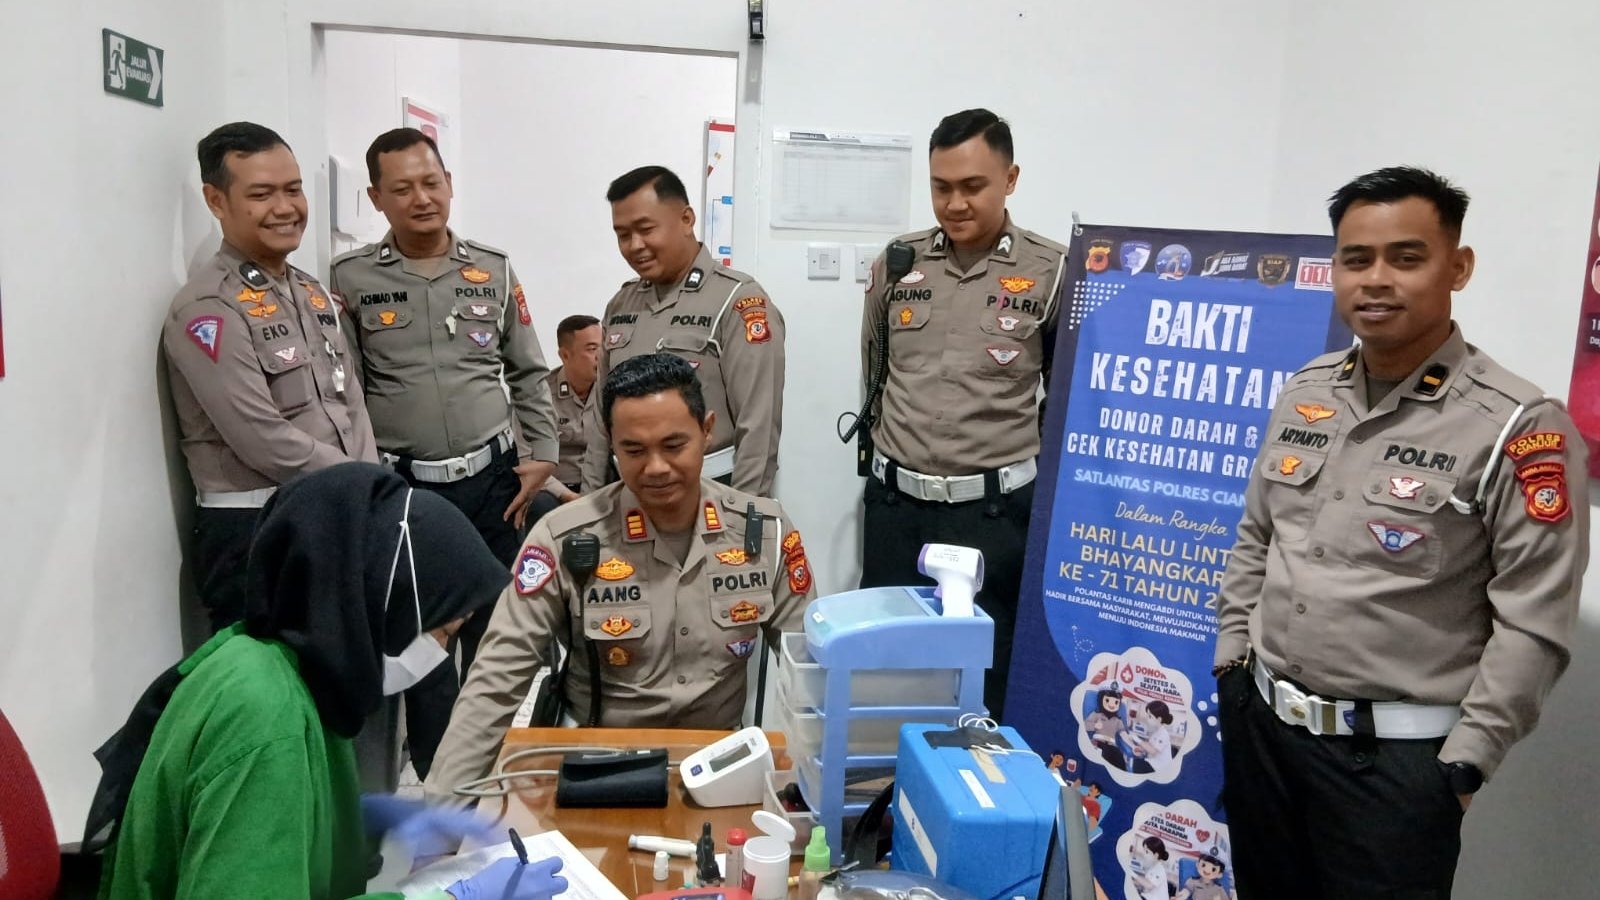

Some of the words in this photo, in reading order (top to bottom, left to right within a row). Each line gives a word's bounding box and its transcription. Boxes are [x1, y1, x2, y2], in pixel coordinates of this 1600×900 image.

[130, 55, 147, 71] JALUR
[360, 292, 391, 306] ACHMAD
[455, 286, 497, 298] POLRI
[889, 288, 932, 302] AGUNG
[986, 294, 1038, 313] POLRI
[262, 323, 289, 341] EKO
[670, 314, 712, 328] POLRI
[1145, 298, 1253, 354] BAKTI
[1100, 407, 1163, 436] DONOR
[1170, 415, 1238, 446] DARAH
[1244, 425, 1258, 449] &
[1278, 426, 1329, 449] ARYANTO
[1509, 433, 1561, 453] POLRES
[1066, 432, 1100, 456] CEK
[1104, 436, 1215, 474] KESEHATAN
[1221, 453, 1257, 479] GR
[1383, 444, 1456, 472] POLRI
[1074, 467, 1150, 493] SATLANTAS
[1153, 479, 1210, 502] POLRES
[1115, 501, 1166, 526] Dalam
[1169, 509, 1229, 541] Rangka
[1070, 521, 1116, 546] HARI
[1121, 530, 1175, 557] LALU
[712, 571, 767, 593] POLRI
[1059, 561, 1083, 582] KE
[1100, 569, 1119, 591] 71
[1124, 575, 1199, 606] TAHUN
[587, 585, 641, 604] AANG
[1074, 586, 1112, 601] POLANTAS
[1133, 600, 1175, 615] MENGABDI
[1176, 608, 1203, 620] UNTUK
[1045, 588, 1066, 601] HADIR
[1067, 594, 1101, 608] BERSAMA
[1152, 614, 1210, 633] MEWUJUDKAN
[1098, 611, 1126, 624] MENUJU
[1127, 618, 1168, 635] INDONESIA
[1168, 628, 1206, 642] MAKMUR
[1165, 811, 1198, 829] DARAH
